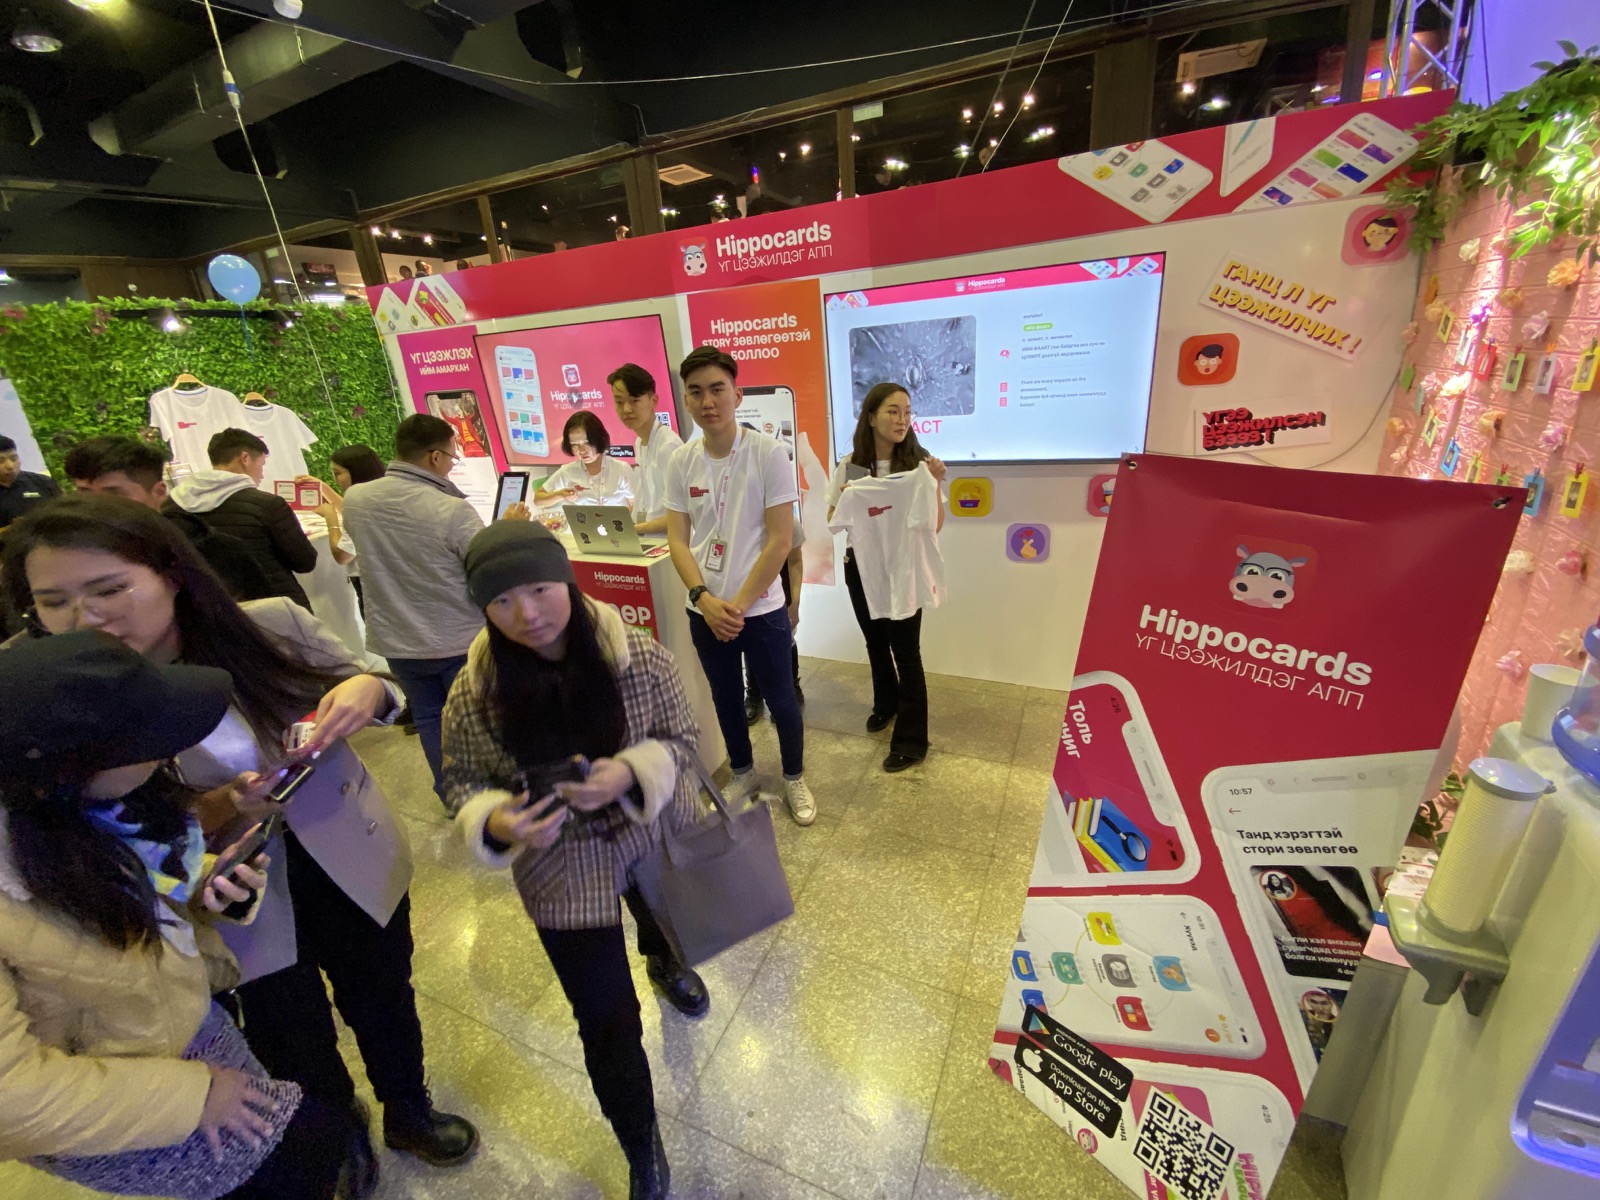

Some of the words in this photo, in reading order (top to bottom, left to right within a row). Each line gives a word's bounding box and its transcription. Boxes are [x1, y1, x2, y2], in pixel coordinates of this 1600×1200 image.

[716, 221, 832, 258] Hippocards
[718, 260, 731, 273] ҮГ
[733, 248, 806, 271] ЦЭЭЖИЛДЭГ
[808, 245, 833, 260] АПП
[968, 277, 1005, 287] Hippocards
[1223, 260, 1284, 299] ГАНЦ
[1281, 282, 1305, 303] Л
[1306, 288, 1337, 314] ҮГ
[710, 312, 797, 336] Hippocards
[1209, 283, 1351, 350] ЦЭЭЖИЛЧИХ
[702, 337, 731, 349] STORY
[733, 328, 811, 347] ЗӨВЛӨГӨӨТЭЙ
[422, 347, 473, 364] ЦЭЭЖЛЭХ
[730, 347, 780, 360] БОЛЛОО
[420, 365, 435, 375] ИЙМ
[436, 363, 470, 374] АМАРХАН
[1202, 407, 1253, 424] ҮГЭЭ
[1203, 411, 1326, 438] ЦЭЭЖИЛСЭН
[594, 571, 645, 584] Hippocards
[1139, 604, 1373, 686] Hippocards
[1135, 633, 1158, 650] ҮГ
[1160, 640, 1305, 691] ЦЭЭЖИЛДЭГ
[1307, 682, 1365, 710] АПП
[1069, 700, 1092, 744] Толь
[1229, 787, 1253, 796] 10:57
[1236, 829, 1272, 841] Танд
[1274, 827, 1343, 841] хэрэгтэй
[1243, 845, 1285, 855] стори
[1287, 845, 1359, 854] зөвлөгөө
[1284, 952, 1317, 961] болгох
[1332, 948, 1361, 957] санал
[1076, 1041, 1087, 1050] APP
[1053, 1033, 1098, 1070] Google
[1099, 1067, 1126, 1091] play
[1048, 1073, 1073, 1095] App
[1074, 1091, 1106, 1123] Store
[1050, 1062, 1087, 1094] Download
[1086, 1091, 1097, 1102] on
[1098, 1098, 1112, 1113] the
